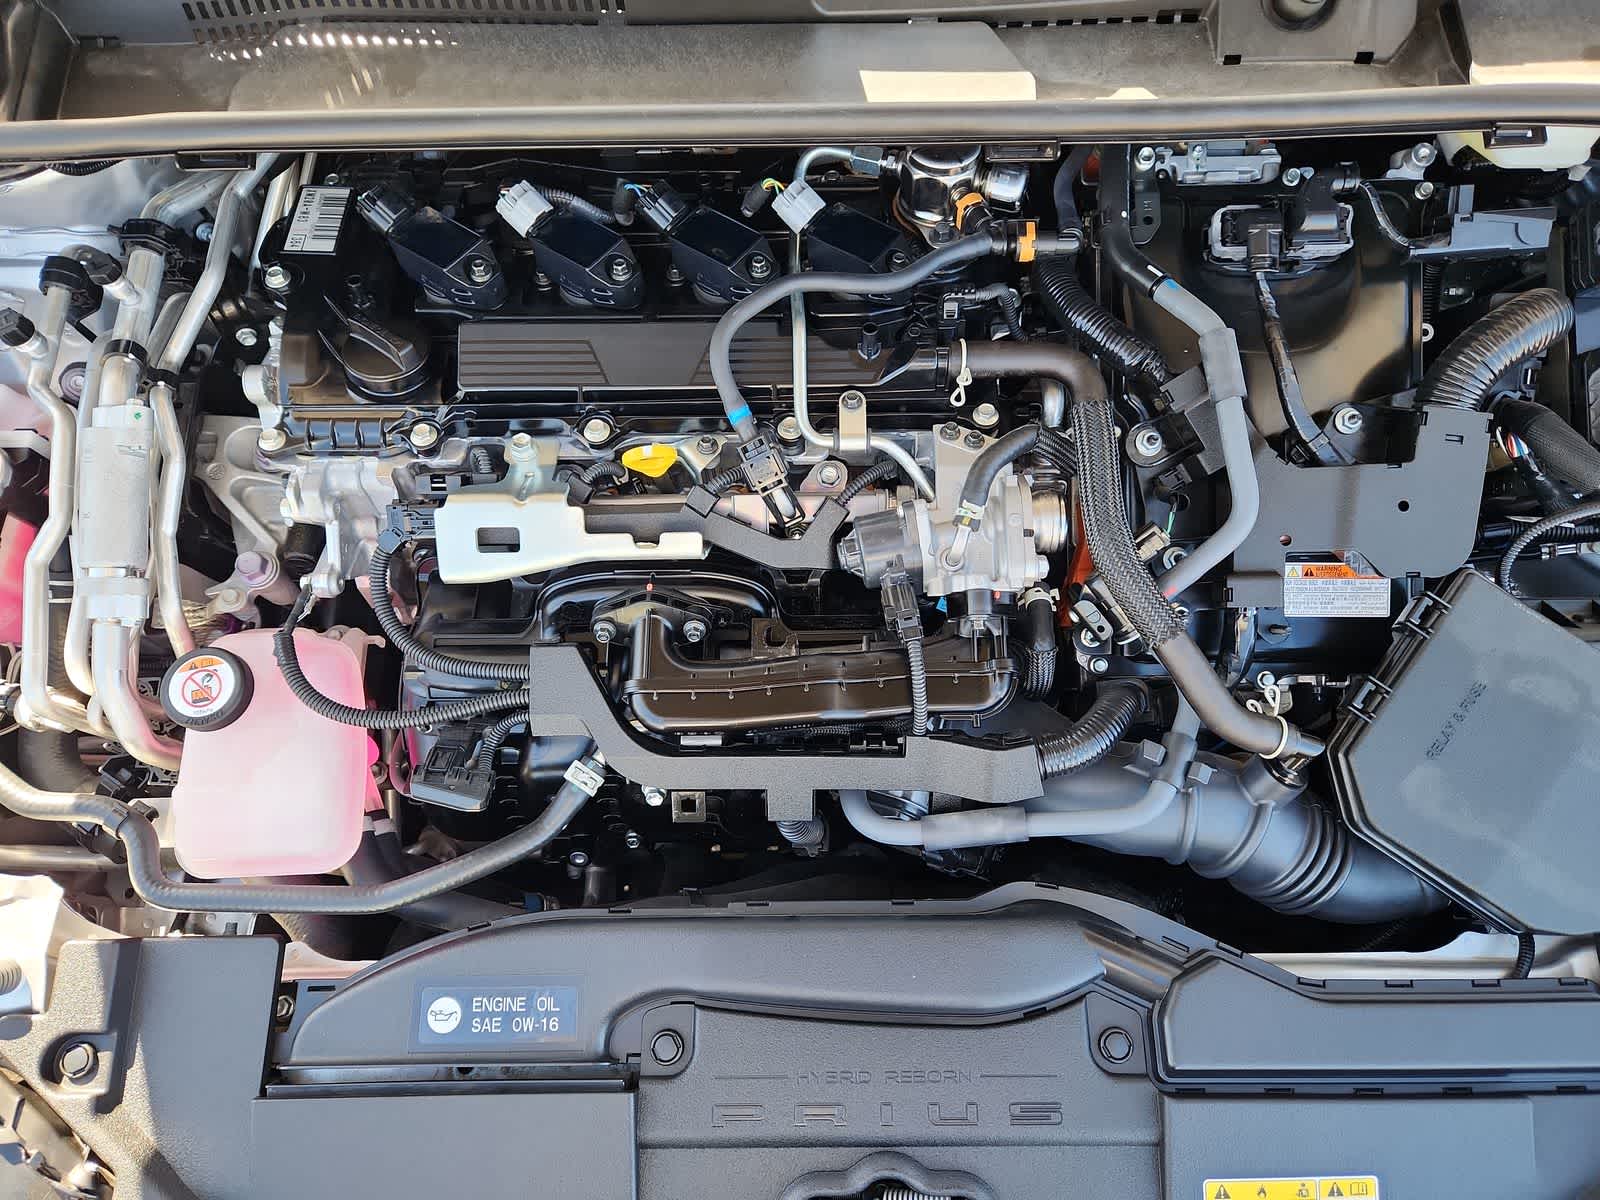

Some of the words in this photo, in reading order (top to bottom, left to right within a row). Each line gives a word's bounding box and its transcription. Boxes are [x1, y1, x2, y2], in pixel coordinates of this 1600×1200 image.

[472, 997, 527, 1012] ENGINE
[536, 996, 560, 1012] OIL
[472, 1017, 502, 1033] SAE
[512, 1017, 559, 1033] 0W-16
[797, 1070, 873, 1085] HYBRID
[884, 1069, 973, 1084] REBORN
[711, 1101, 1063, 1128] PRIUS
